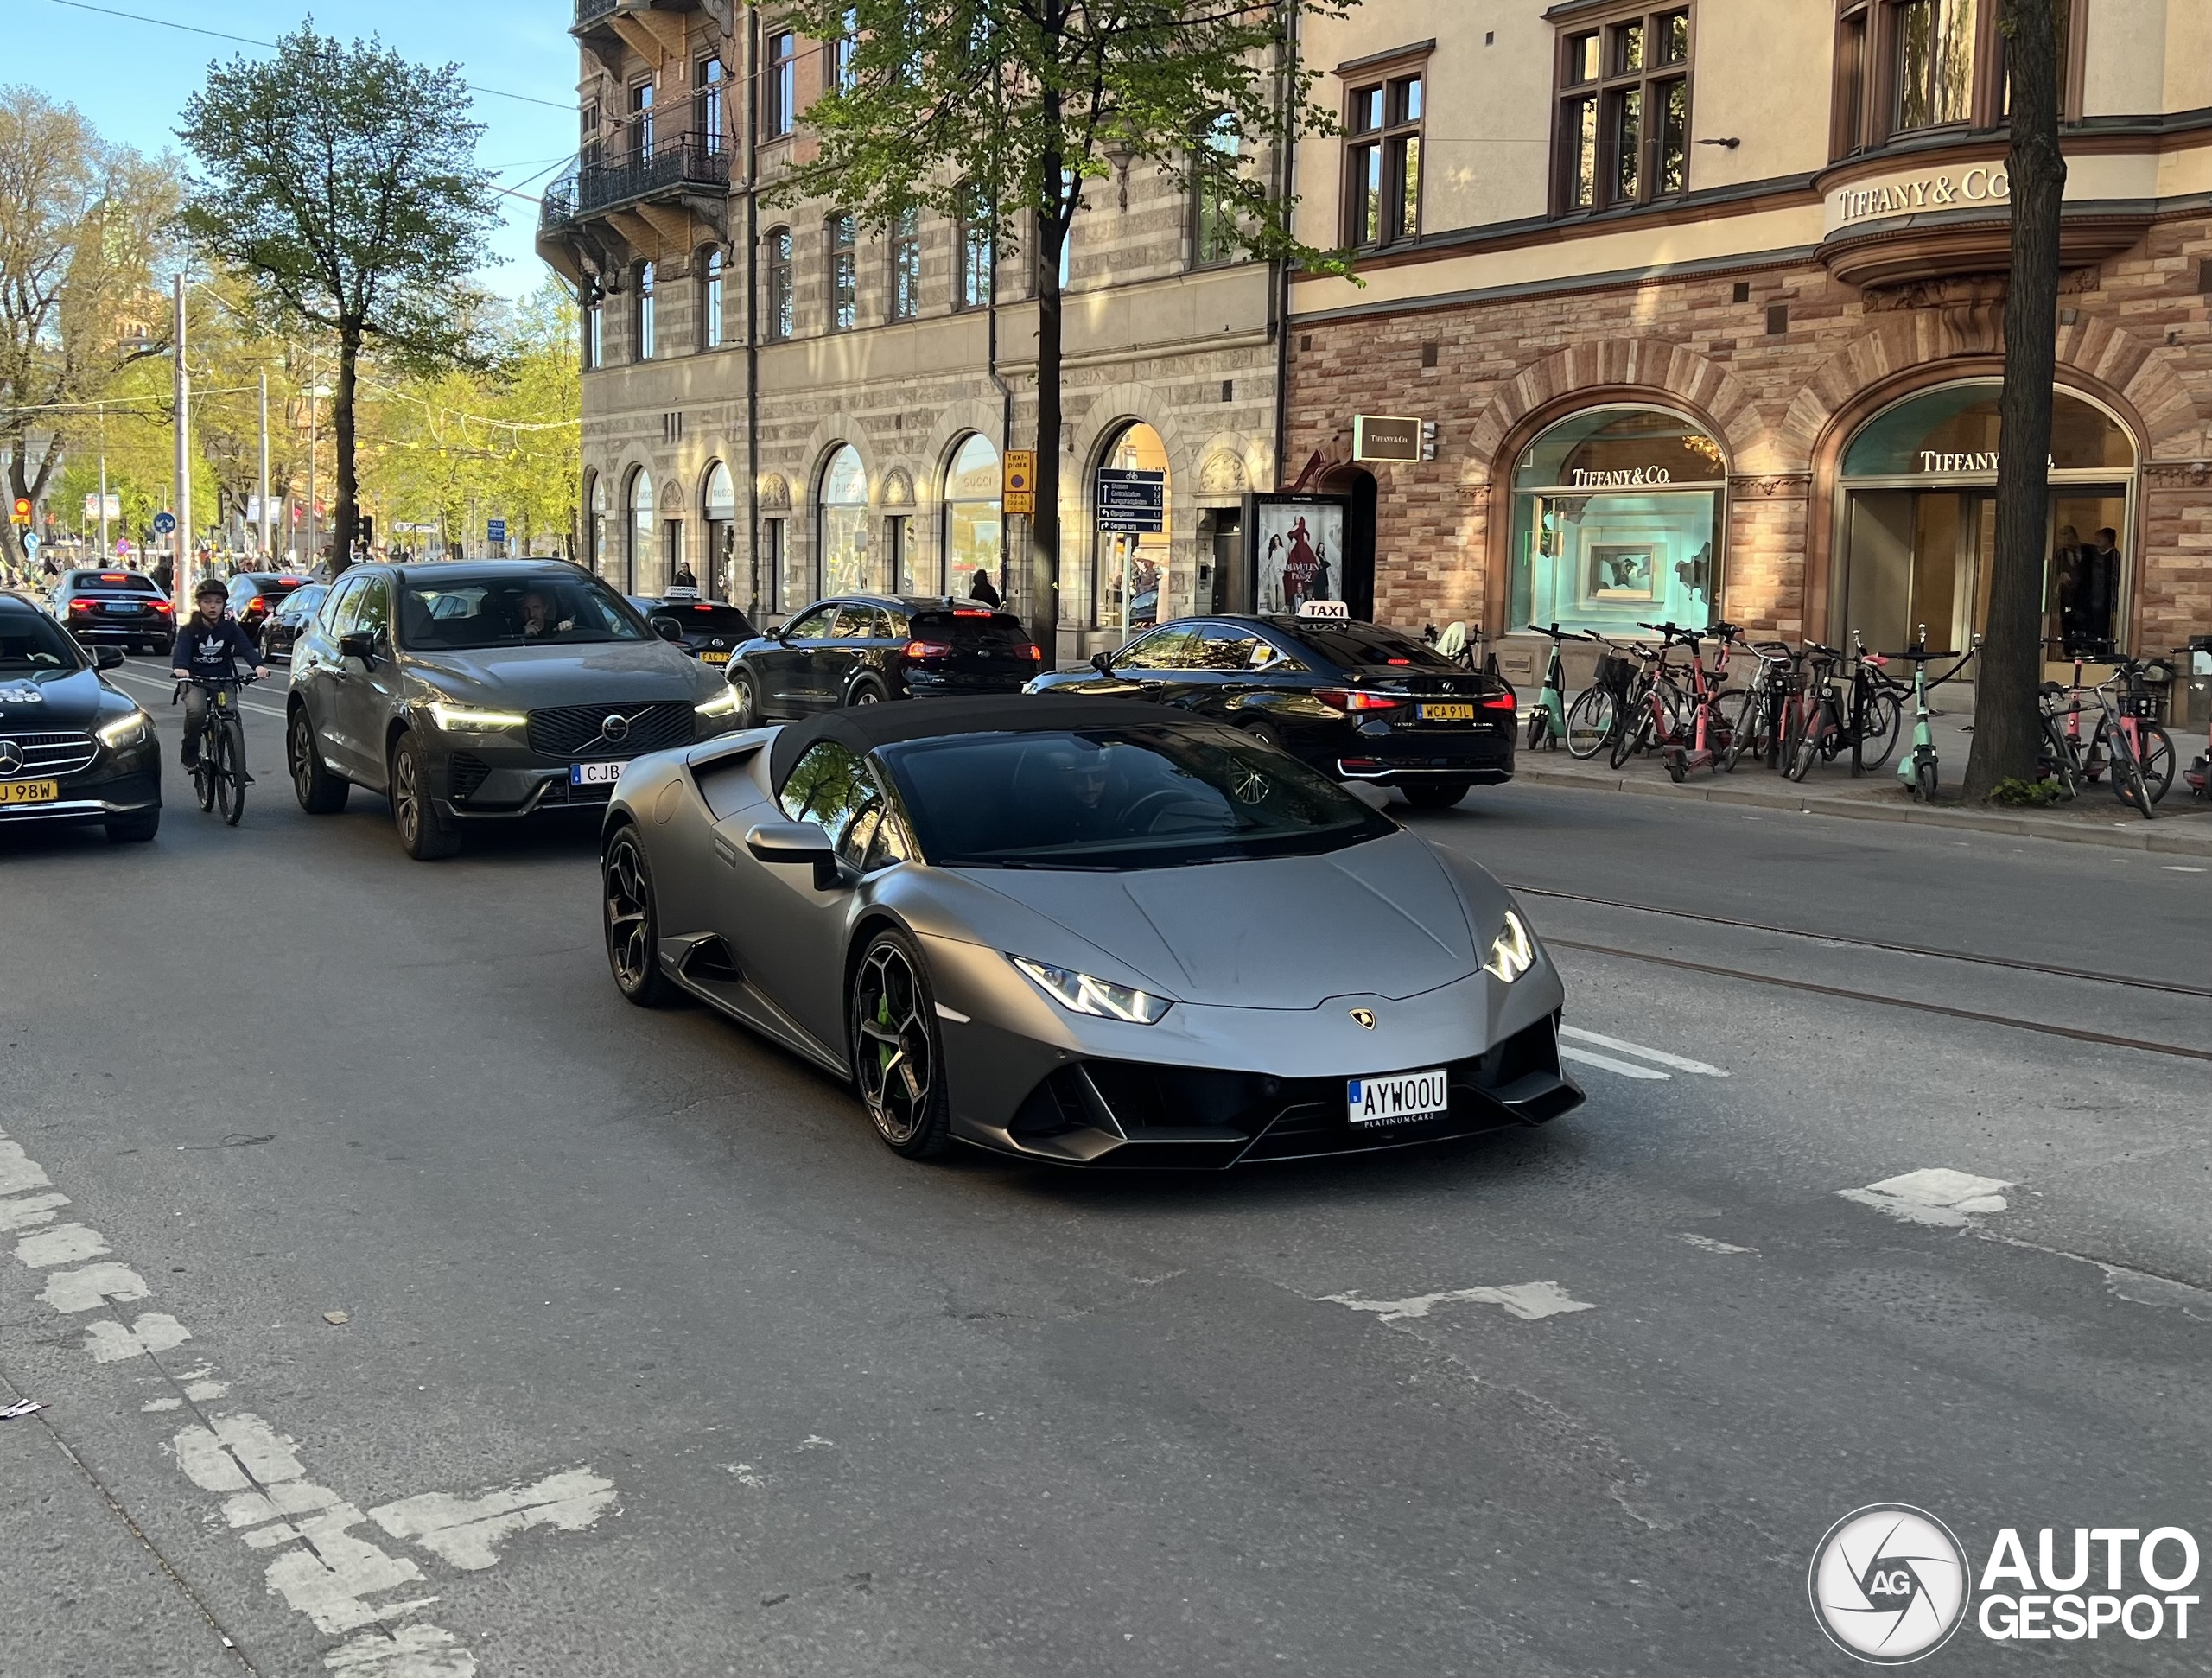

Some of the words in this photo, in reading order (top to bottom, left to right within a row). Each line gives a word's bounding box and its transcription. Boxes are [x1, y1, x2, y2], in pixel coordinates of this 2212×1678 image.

[963, 477, 993, 487] GUCCI
[836, 483, 860, 493] GUCCI
[1309, 606, 1344, 617] TAXI
[702, 652, 718, 661] FAC
[1426, 706, 1447, 717] WCA
[1449, 706, 1470, 718] 91L
[588, 765, 620, 781] CJB
[16, 782, 50, 801] 98W
